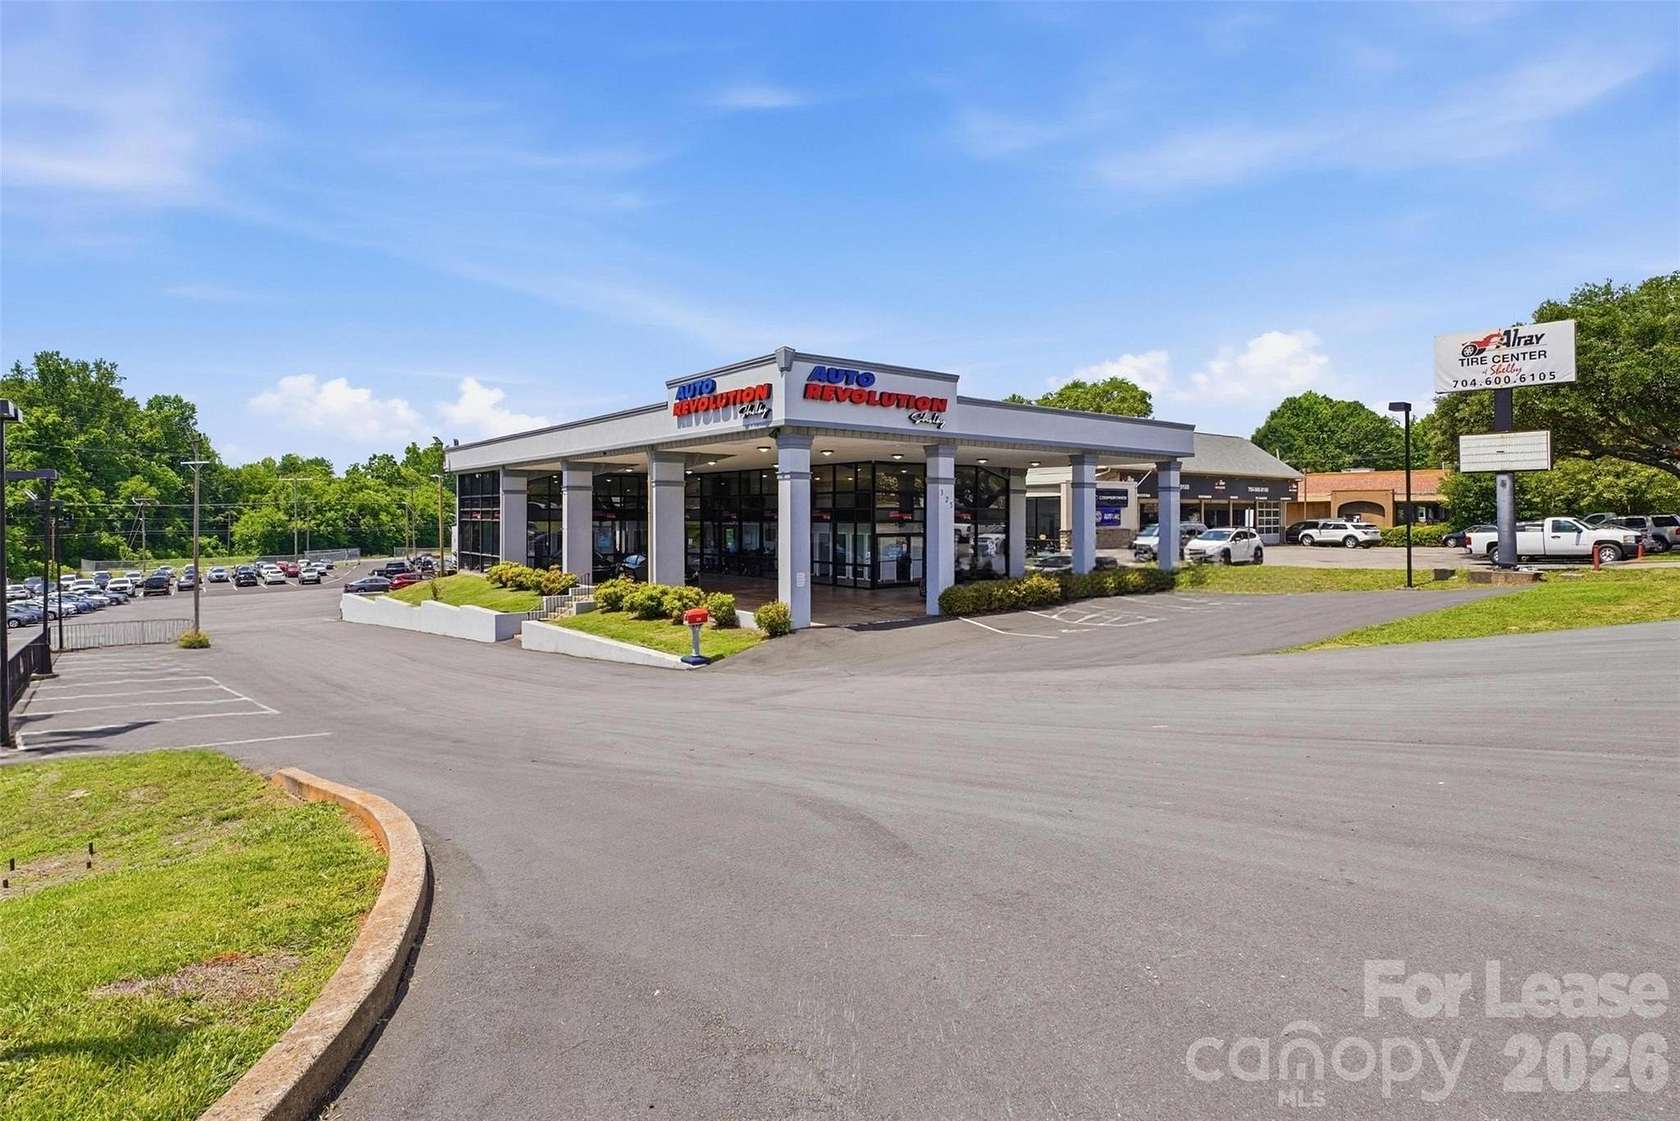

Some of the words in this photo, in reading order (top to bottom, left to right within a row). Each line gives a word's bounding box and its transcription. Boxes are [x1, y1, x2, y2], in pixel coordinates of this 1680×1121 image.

[1458, 355, 1488, 368] TIRE
[1491, 349, 1547, 365] CENTER
[806, 366, 875, 388] AUTO
[1452, 371, 1557, 388] 704.600.6105
[1489, 363, 1522, 376] Shelby
[675, 378, 717, 401] AUTO
[803, 383, 948, 412] REVOLUTION
[673, 383, 773, 417] REVOLUTION
[909, 411, 946, 429] Shelby
